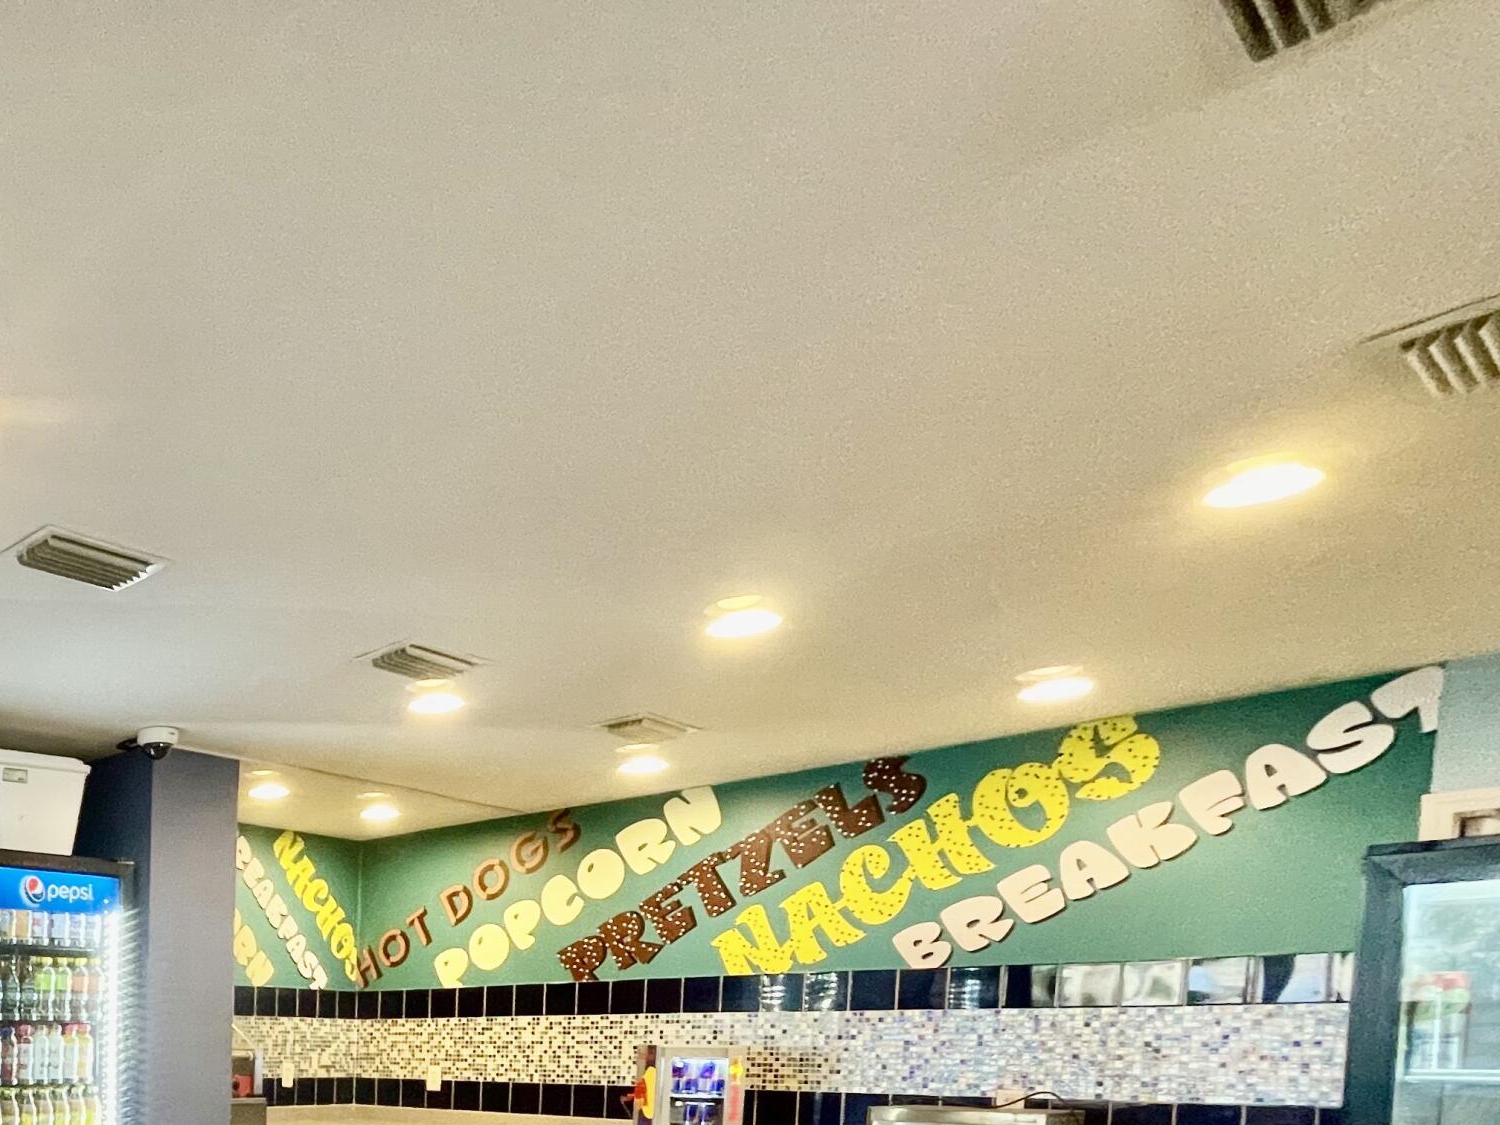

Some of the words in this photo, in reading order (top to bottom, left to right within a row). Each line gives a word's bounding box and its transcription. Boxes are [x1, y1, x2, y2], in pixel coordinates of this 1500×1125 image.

[47, 883, 93, 903] pepsi
[236, 834, 328, 990] REAKFAST
[273, 830, 357, 982] NACHOS
[357, 905, 432, 988] HOT
[440, 808, 581, 926] DOGS
[433, 786, 722, 988] POPCORN
[557, 756, 927, 981] PRETZELS
[711, 714, 1161, 976] NACHOS
[892, 665, 1445, 969] BREAKFAST
